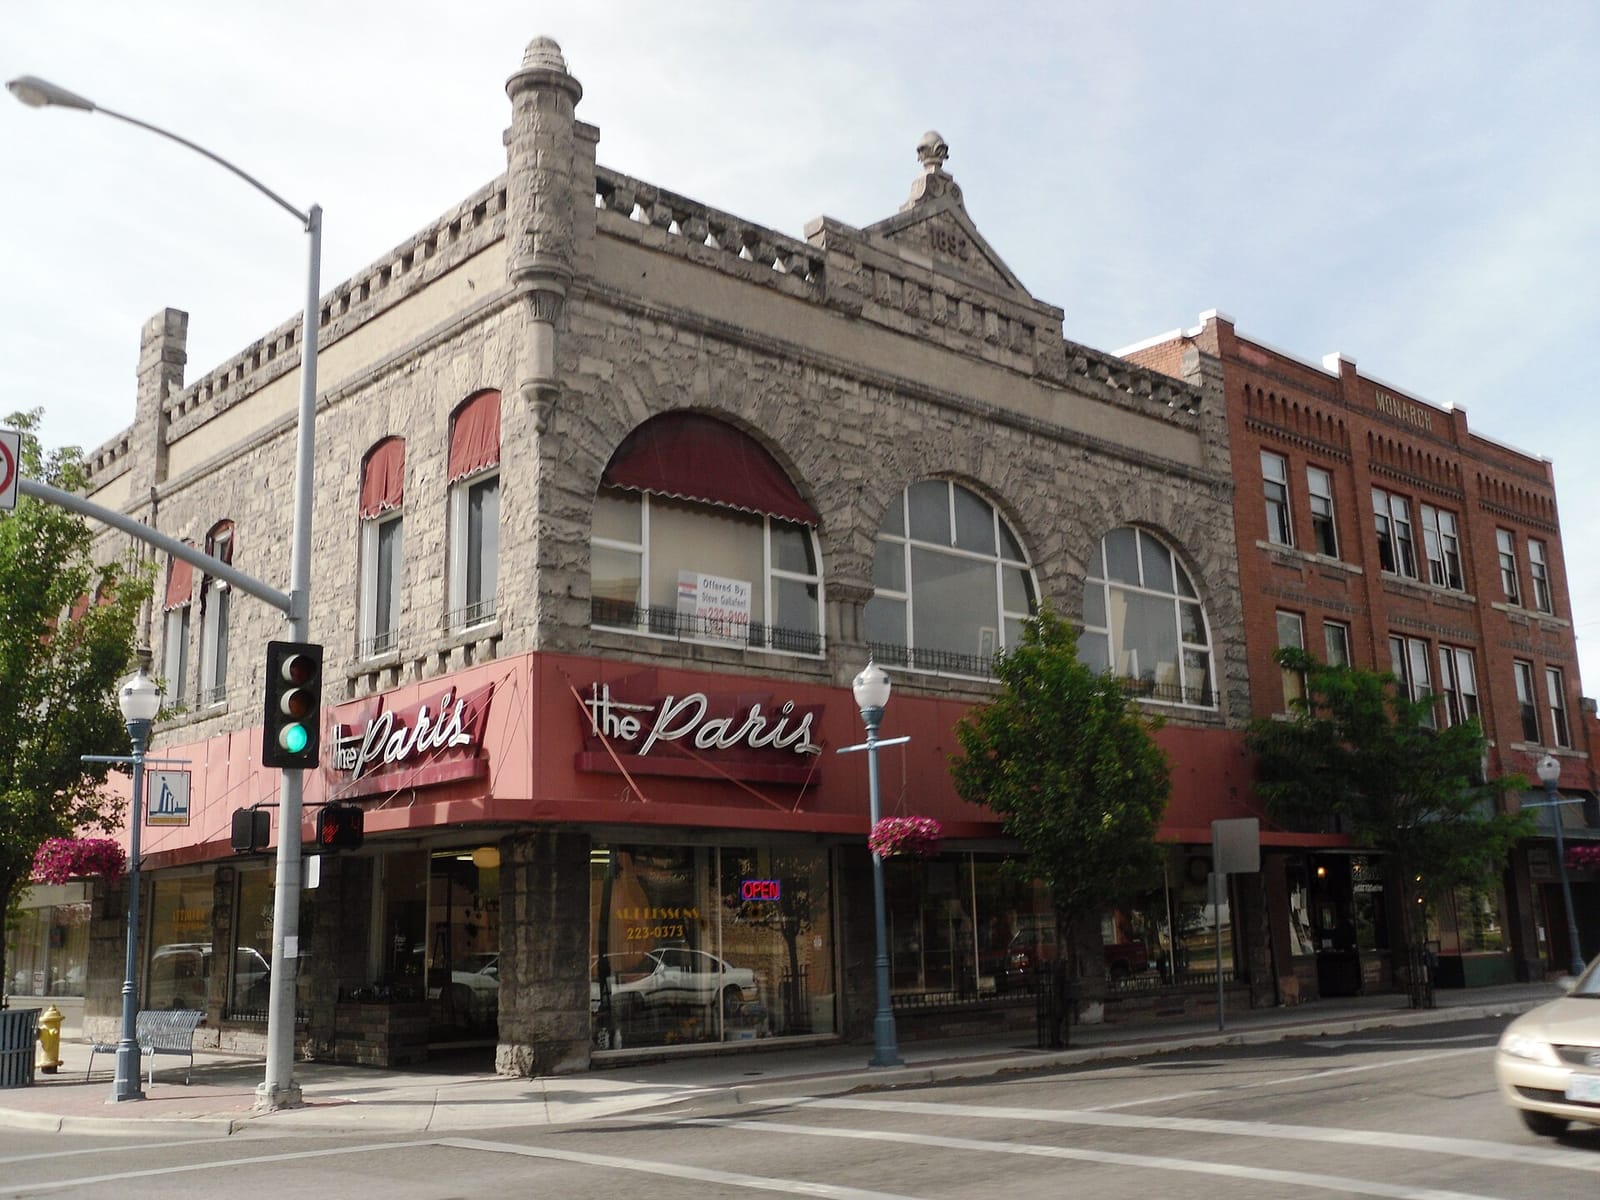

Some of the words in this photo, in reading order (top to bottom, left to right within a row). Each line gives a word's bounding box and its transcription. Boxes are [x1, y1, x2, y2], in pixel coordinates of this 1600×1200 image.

[1375, 389, 1432, 431] MONARCH
[703, 578, 732, 593] Offered
[585, 681, 655, 741] the
[638, 692, 822, 757] Paris
[332, 722, 365, 770] the
[353, 692, 471, 780] Paris
[742, 880, 779, 899] OPEN
[626, 924, 685, 940] 223-0373
